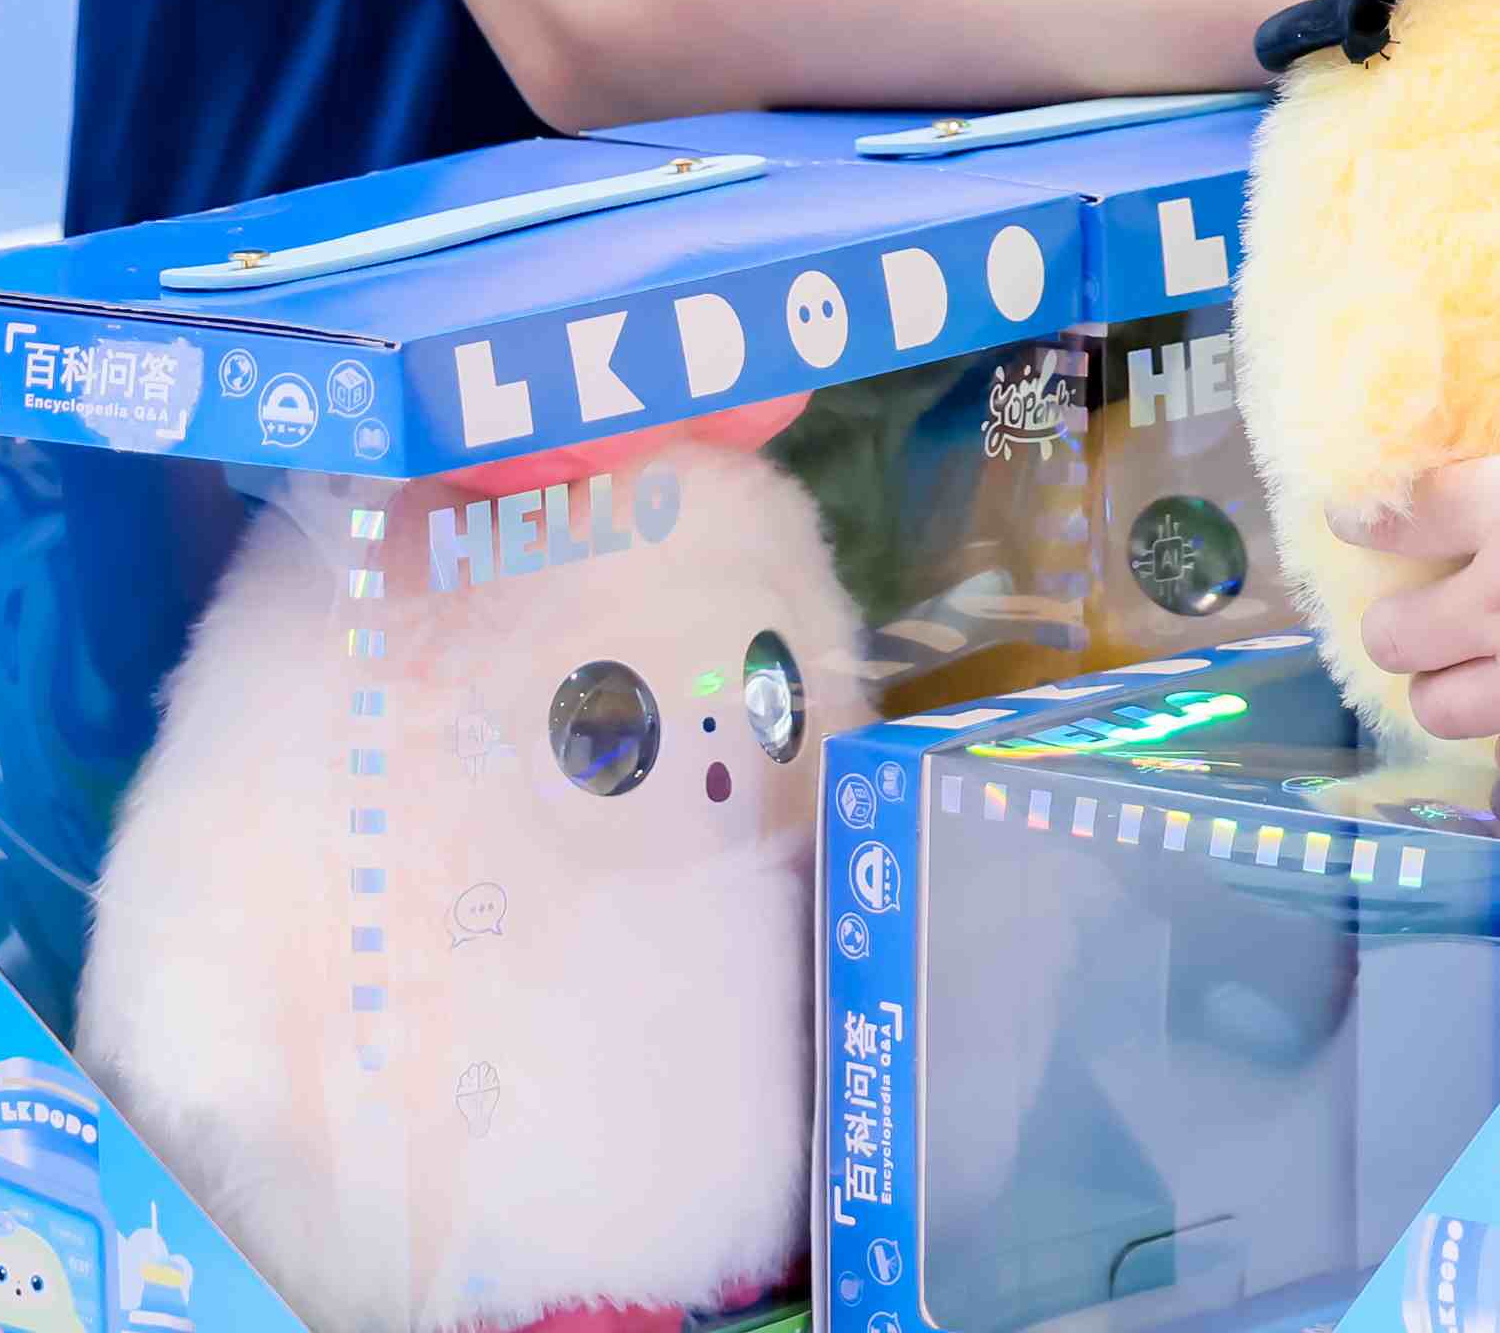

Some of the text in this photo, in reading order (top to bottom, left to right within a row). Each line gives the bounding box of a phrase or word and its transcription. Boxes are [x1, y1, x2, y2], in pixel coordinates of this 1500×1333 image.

[24, 341, 179, 404] 百科问答
[24, 393, 169, 422] Encyclopedia Q&A
[455, 225, 1045, 448] LKDODO
[427, 460, 682, 593] HELLO
[843, 1010, 878, 1203] 百科问答
[880, 1024, 893, 1205] Encyclopedia Q&A
